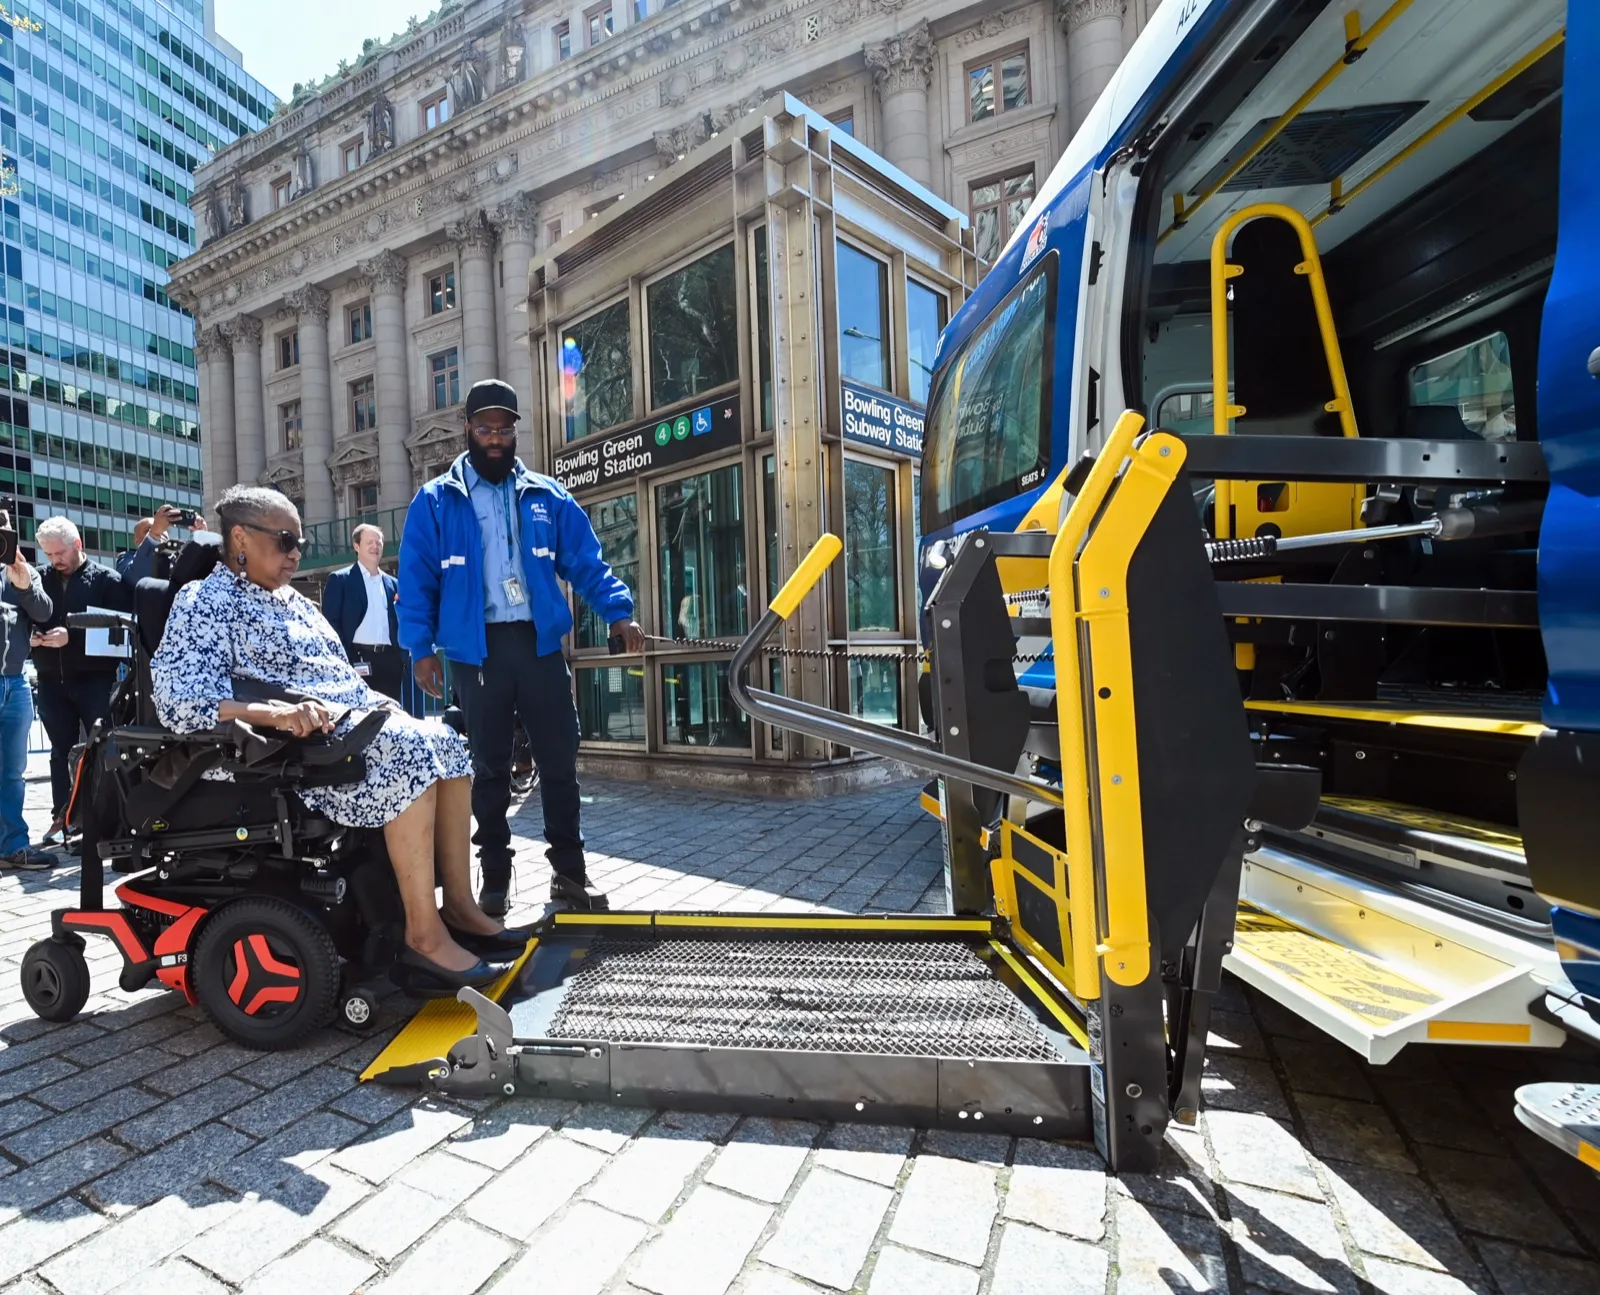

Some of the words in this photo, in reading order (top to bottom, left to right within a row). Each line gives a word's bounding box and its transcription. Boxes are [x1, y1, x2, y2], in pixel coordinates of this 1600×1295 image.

[844, 390, 891, 426] Bowling
[894, 407, 924, 432] Green
[845, 413, 892, 446] Subway
[895, 428, 923, 452] Statio
[555, 449, 598, 475] Bowling
[603, 434, 643, 458] Green
[556, 467, 600, 490] Subway
[604, 451, 652, 477] Station
[1021, 470, 1039, 486] SEATS
[1040, 467, 1045, 478] 4
[177, 953, 188, 963] F3
